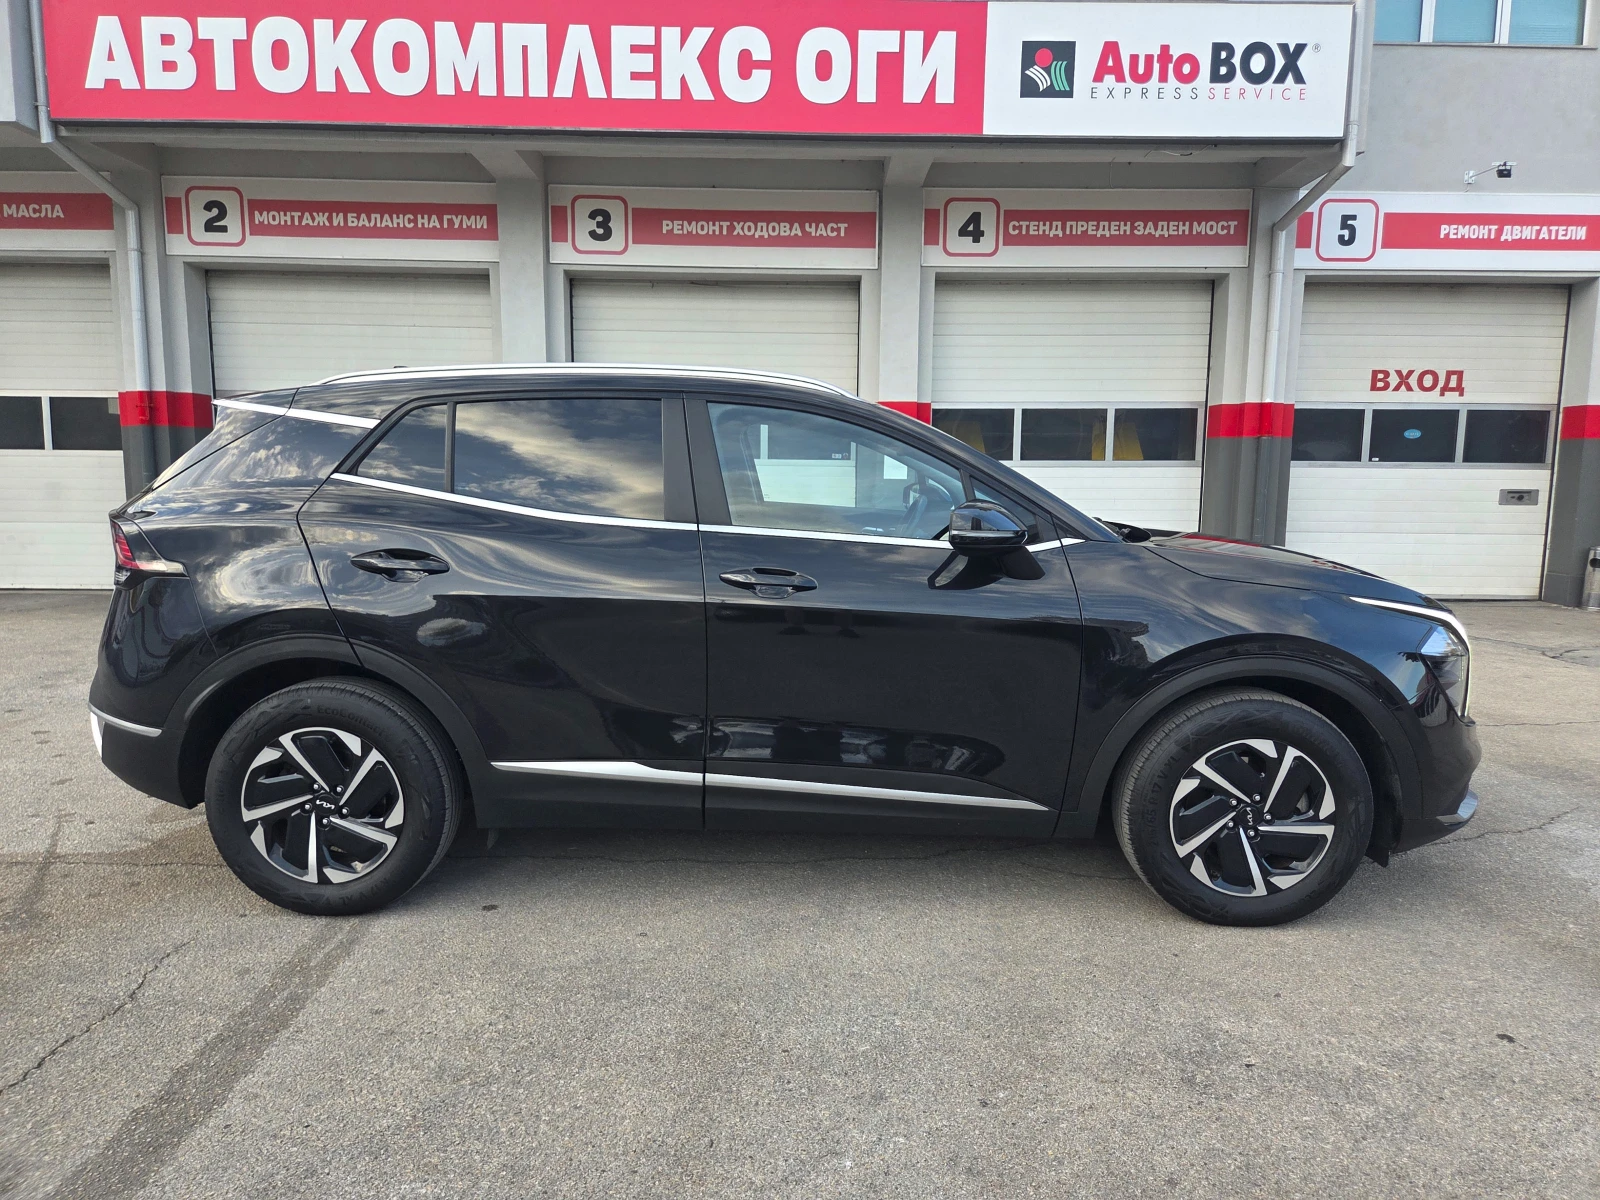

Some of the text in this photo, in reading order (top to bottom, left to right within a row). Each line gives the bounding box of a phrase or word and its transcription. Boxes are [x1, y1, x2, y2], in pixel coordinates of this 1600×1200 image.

[85, 16, 957, 104] АВТОКОМПЛЕКС ОГИ
[1092, 41, 1307, 85] Auto BOX
[1090, 87, 1306, 101] EXPRESS SERVICE
[3, 204, 65, 218] МАСЛА
[203, 200, 229, 232] 2
[254, 211, 488, 229] МОНТАЖ И БАЛАНС НА ГУМИ
[588, 209, 613, 242] 3
[662, 220, 849, 238] РЕМОНТ ХОДОВА ЧАСТ
[957, 211, 985, 244] 4
[1008, 221, 1238, 238] СТЕНД ПРЕДЕН ЗАДЕН МОСТ
[1337, 214, 1357, 247] 5
[1440, 225, 1587, 241] РЕМОНТ ДВИГАТЕЛИ
[1370, 369, 1465, 397] ВХОД
